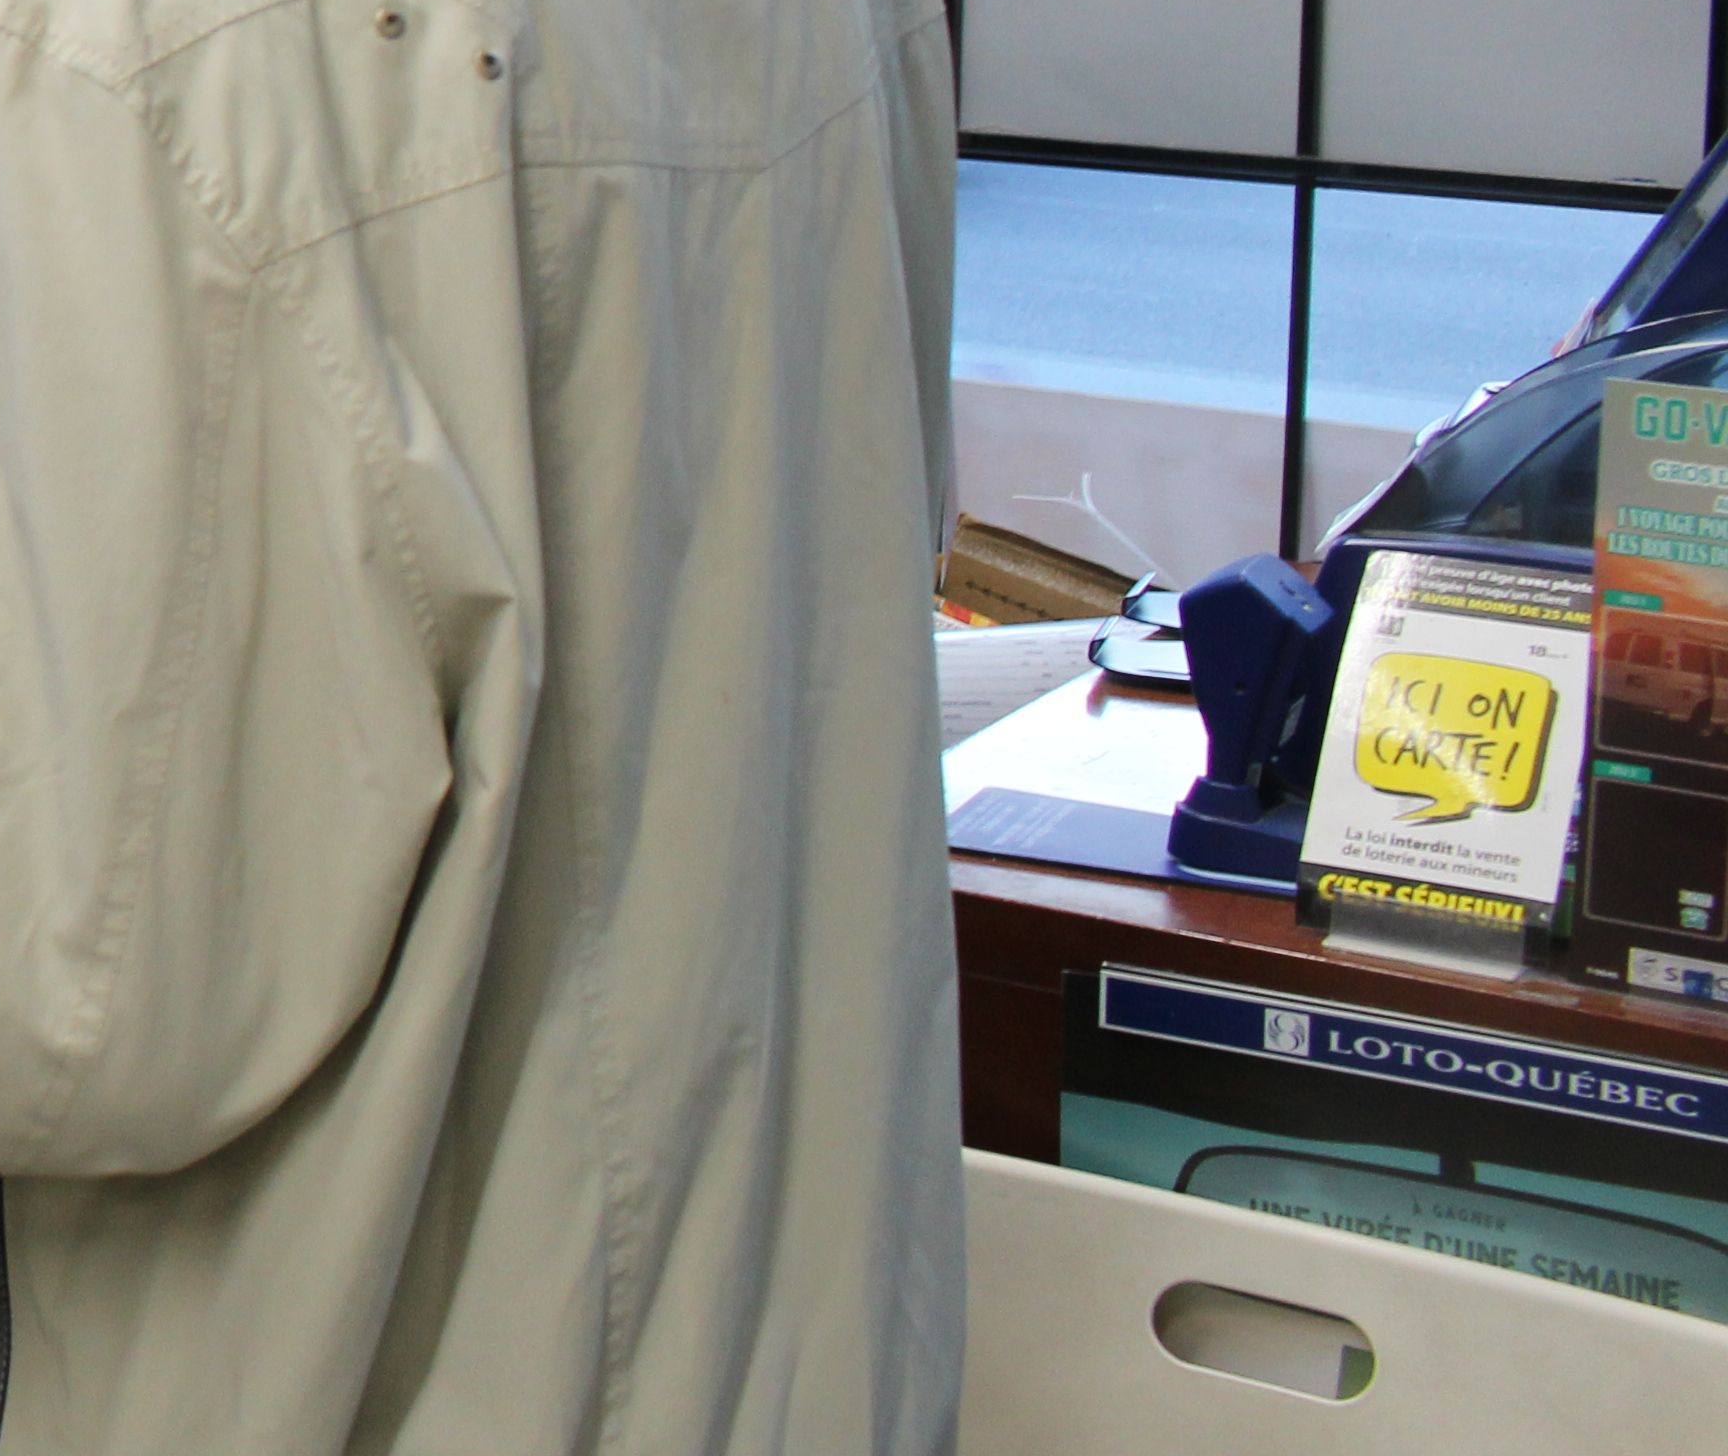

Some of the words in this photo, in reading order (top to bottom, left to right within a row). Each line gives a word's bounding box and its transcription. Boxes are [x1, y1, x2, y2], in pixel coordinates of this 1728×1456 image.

[1652, 462, 1712, 484] GROS
[1630, 508, 1696, 534] VOYAGE
[1609, 533, 1640, 553] LES
[1428, 564, 1476, 581] preuve
[1516, 575, 1550, 588] avec
[1419, 592, 1466, 609] AVOIR
[1466, 597, 1518, 616] MOINS
[1518, 604, 1541, 618] DE
[1541, 607, 1561, 621] 25
[1532, 590, 1570, 607] client
[1386, 676, 1442, 716] ICI
[1373, 726, 1519, 781] CARTE!
[1345, 826, 1362, 841] La
[1367, 829, 1386, 845] loi
[1390, 832, 1453, 856] interdit
[1455, 843, 1470, 858] la
[1475, 850, 1521, 866] vente
[1342, 843, 1360, 857] de
[1364, 848, 1415, 866] loterie
[1419, 858, 1448, 871] aux
[1452, 862, 1518, 884] mineurs
[1318, 871, 1394, 901] C'EST
[1327, 1028, 1700, 1119] LOTO-QUÉBEC
[1432, 1204, 1506, 1231] GAGNER
[1531, 1253, 1681, 1310] SEMAINE
